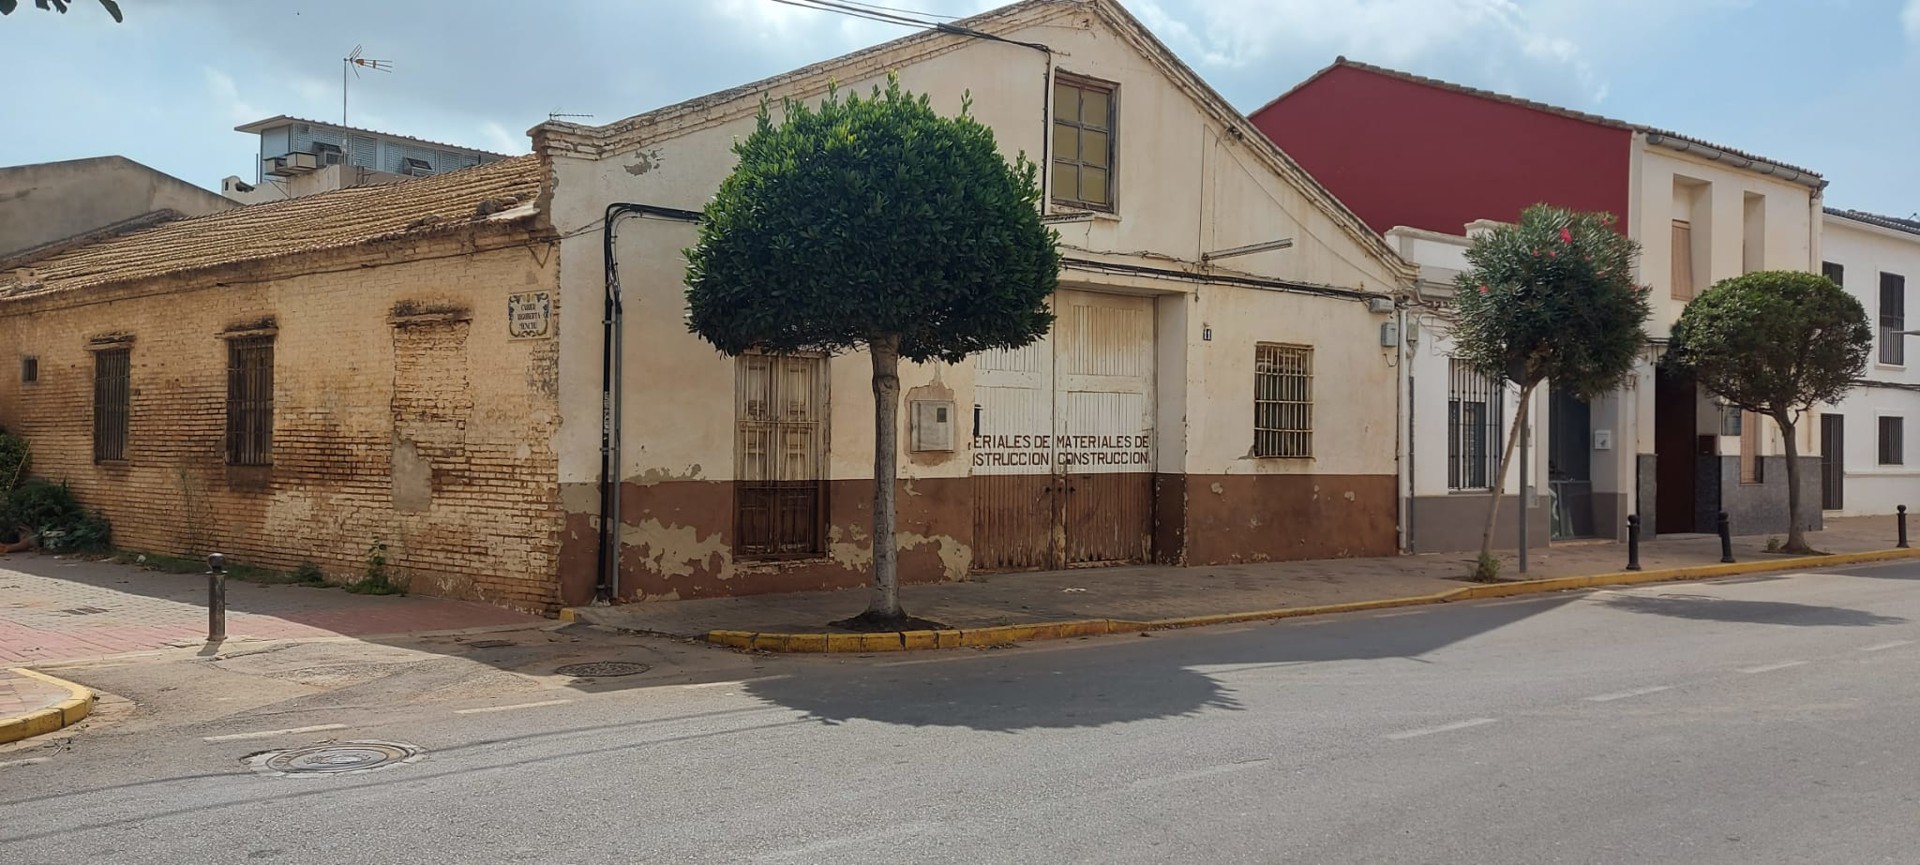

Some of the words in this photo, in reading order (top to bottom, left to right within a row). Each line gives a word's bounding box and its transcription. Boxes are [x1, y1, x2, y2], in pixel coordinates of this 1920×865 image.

[1034, 435, 1051, 449] DE
[1056, 435, 1132, 449] MATERIALES
[1134, 435, 1150, 448] DE
[1057, 452, 1148, 466] CONSTRUCCION
